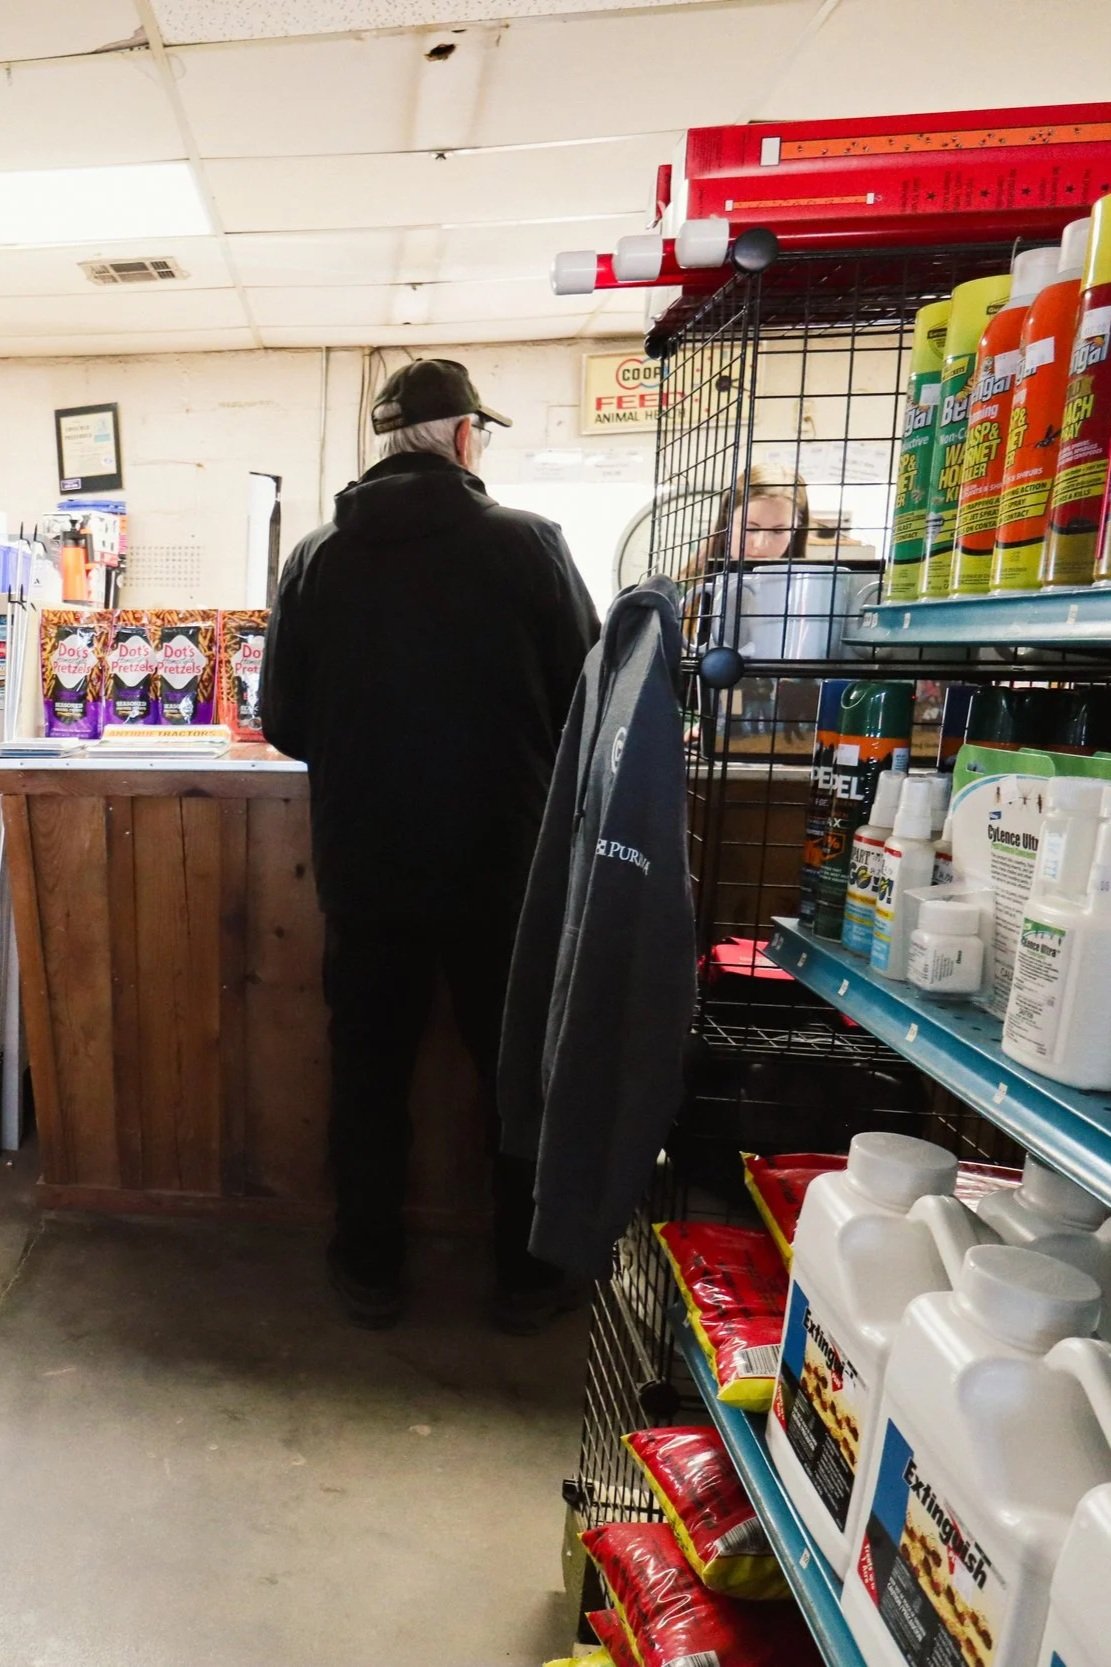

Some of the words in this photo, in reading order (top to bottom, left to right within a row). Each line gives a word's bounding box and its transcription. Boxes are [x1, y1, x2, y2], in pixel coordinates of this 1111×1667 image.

[595, 409, 639, 424] ANIMAL
[120, 644, 149, 657] Dot's
[164, 644, 195, 658] Dot's
[111, 660, 154, 672] Pretzels
[156, 662, 201, 674] Pretzels
[157, 728, 216, 737] TRACTORS
[903, 1458, 988, 1591] Extinguish
